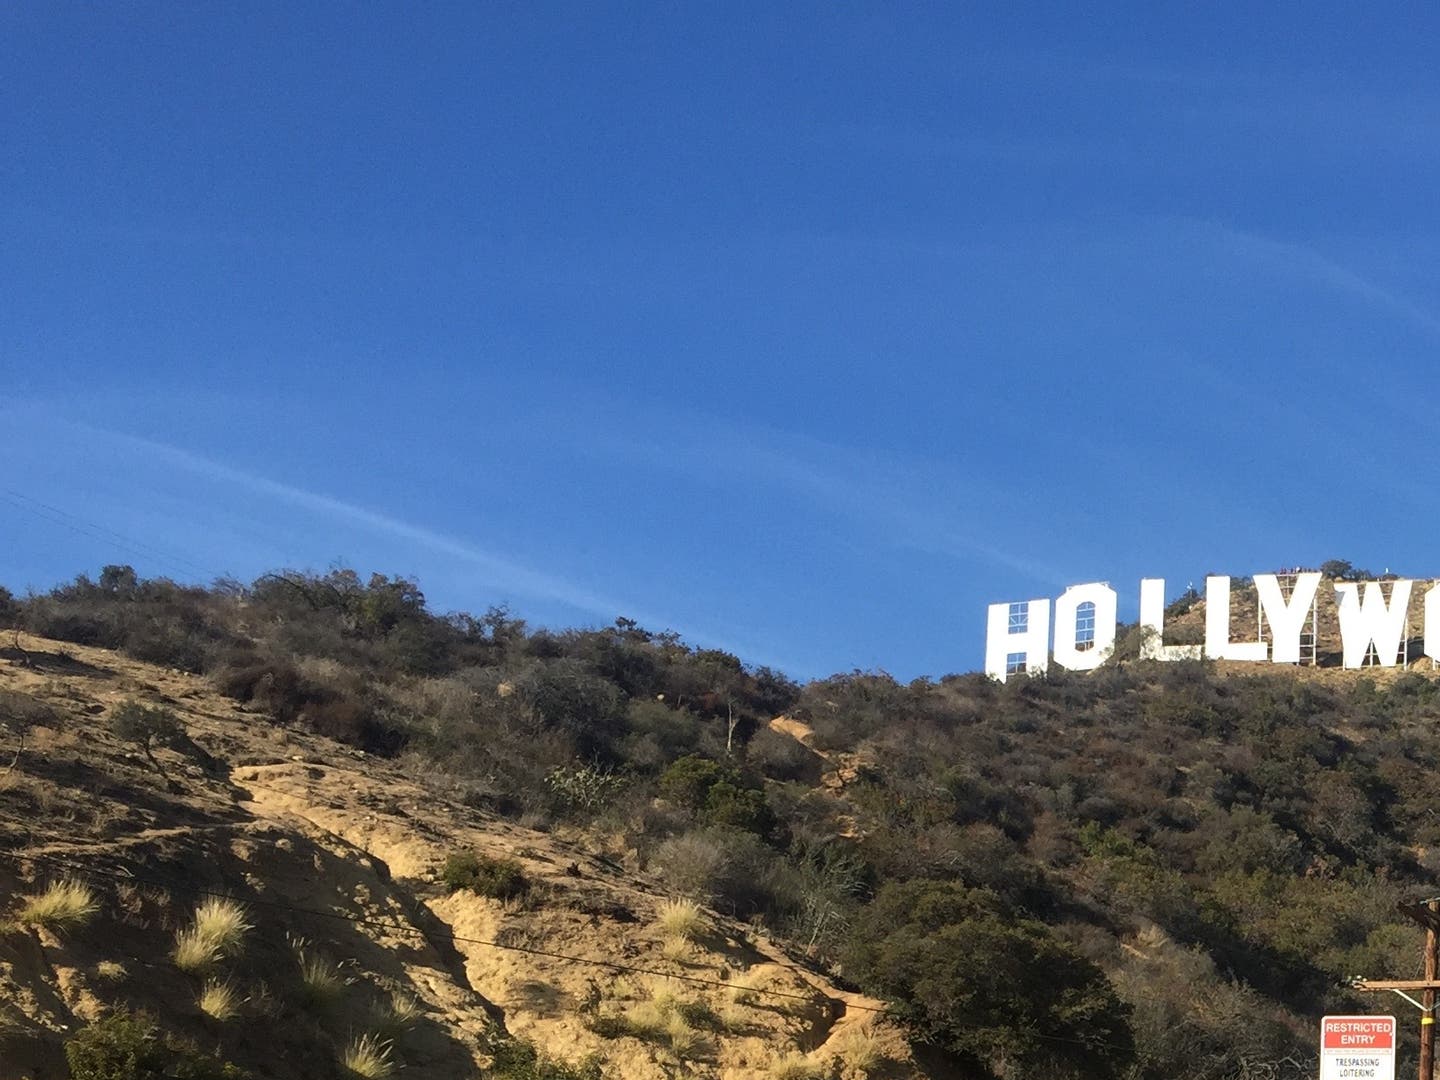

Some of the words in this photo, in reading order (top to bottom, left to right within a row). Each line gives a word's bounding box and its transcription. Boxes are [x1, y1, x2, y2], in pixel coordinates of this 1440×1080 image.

[1326, 1023, 1391, 1033] RESTRICTED
[1341, 1035, 1376, 1044] ENTRY
[1335, 1058, 1380, 1067] TRESPASSING
[1339, 1068, 1375, 1078] LOITERING
